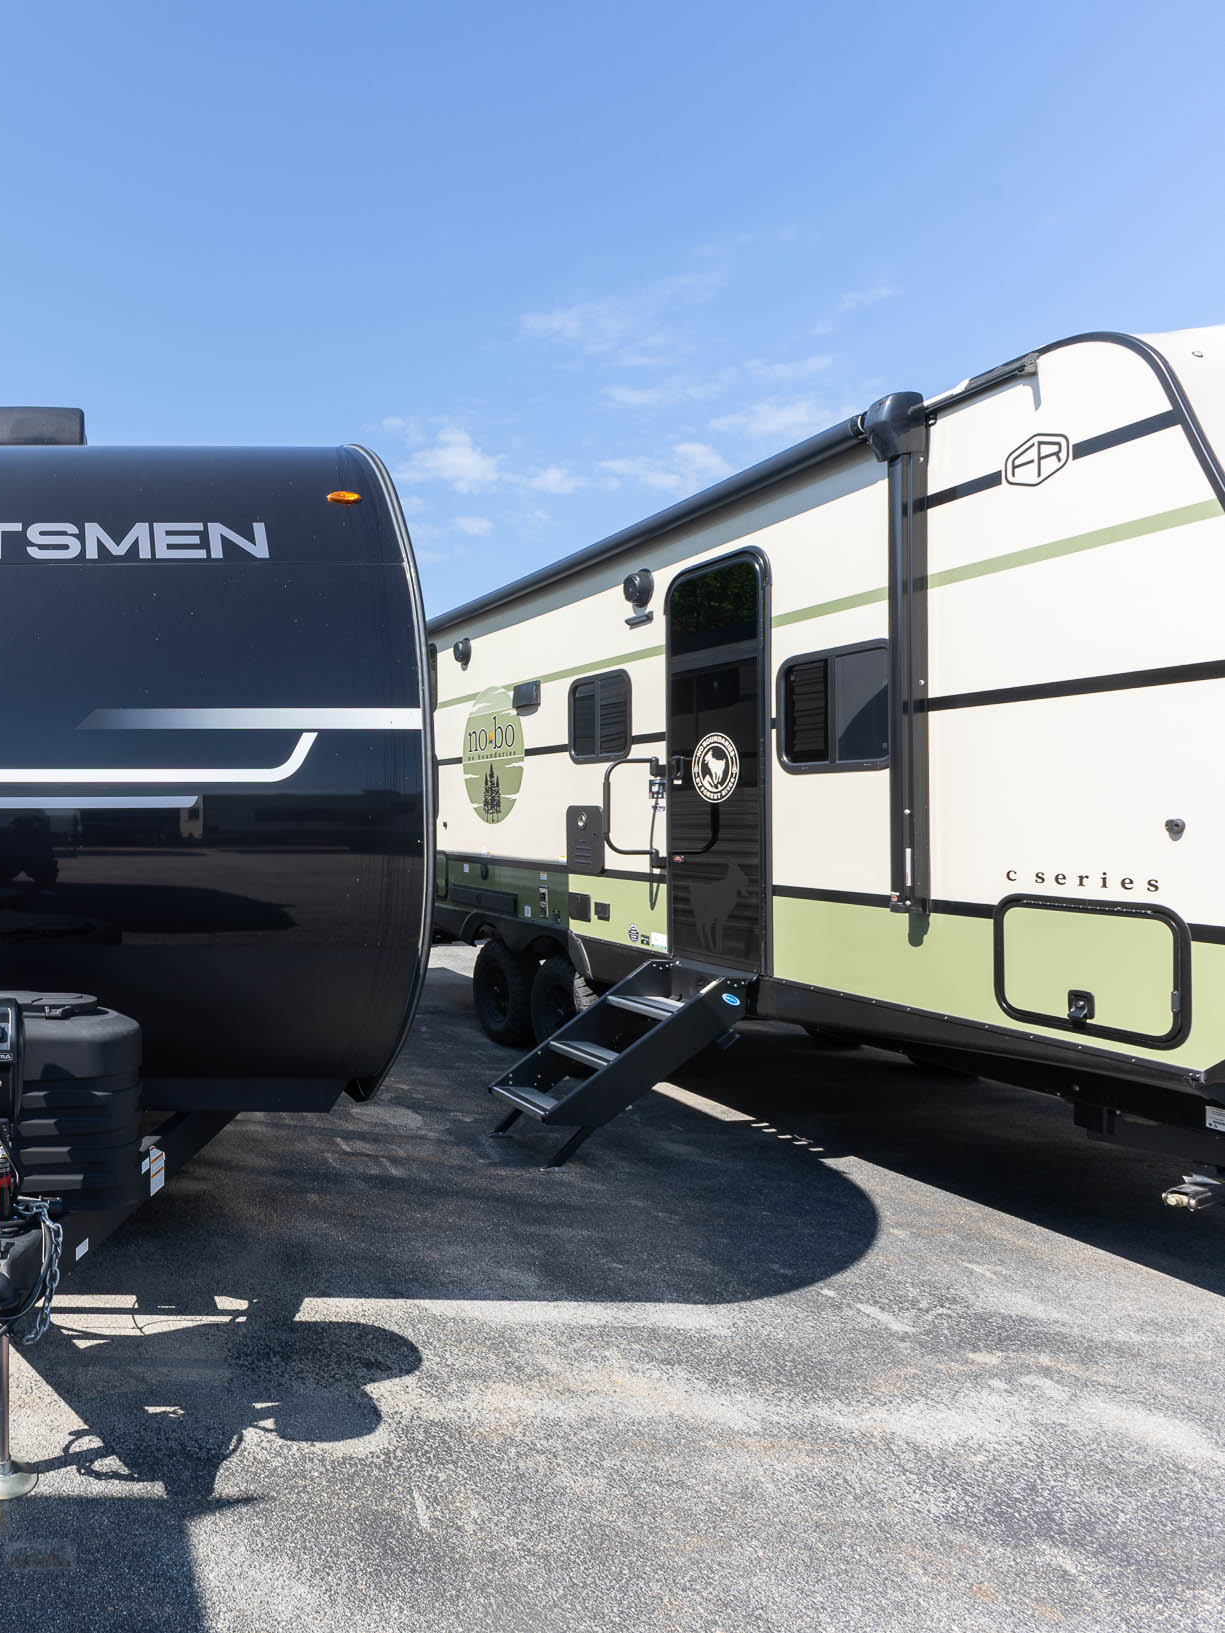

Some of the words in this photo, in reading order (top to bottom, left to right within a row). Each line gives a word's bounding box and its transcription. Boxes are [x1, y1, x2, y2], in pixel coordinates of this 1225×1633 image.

[1011, 440, 1062, 478] FR
[1006, 869, 1018, 882] c
[1034, 871, 1160, 892] series
